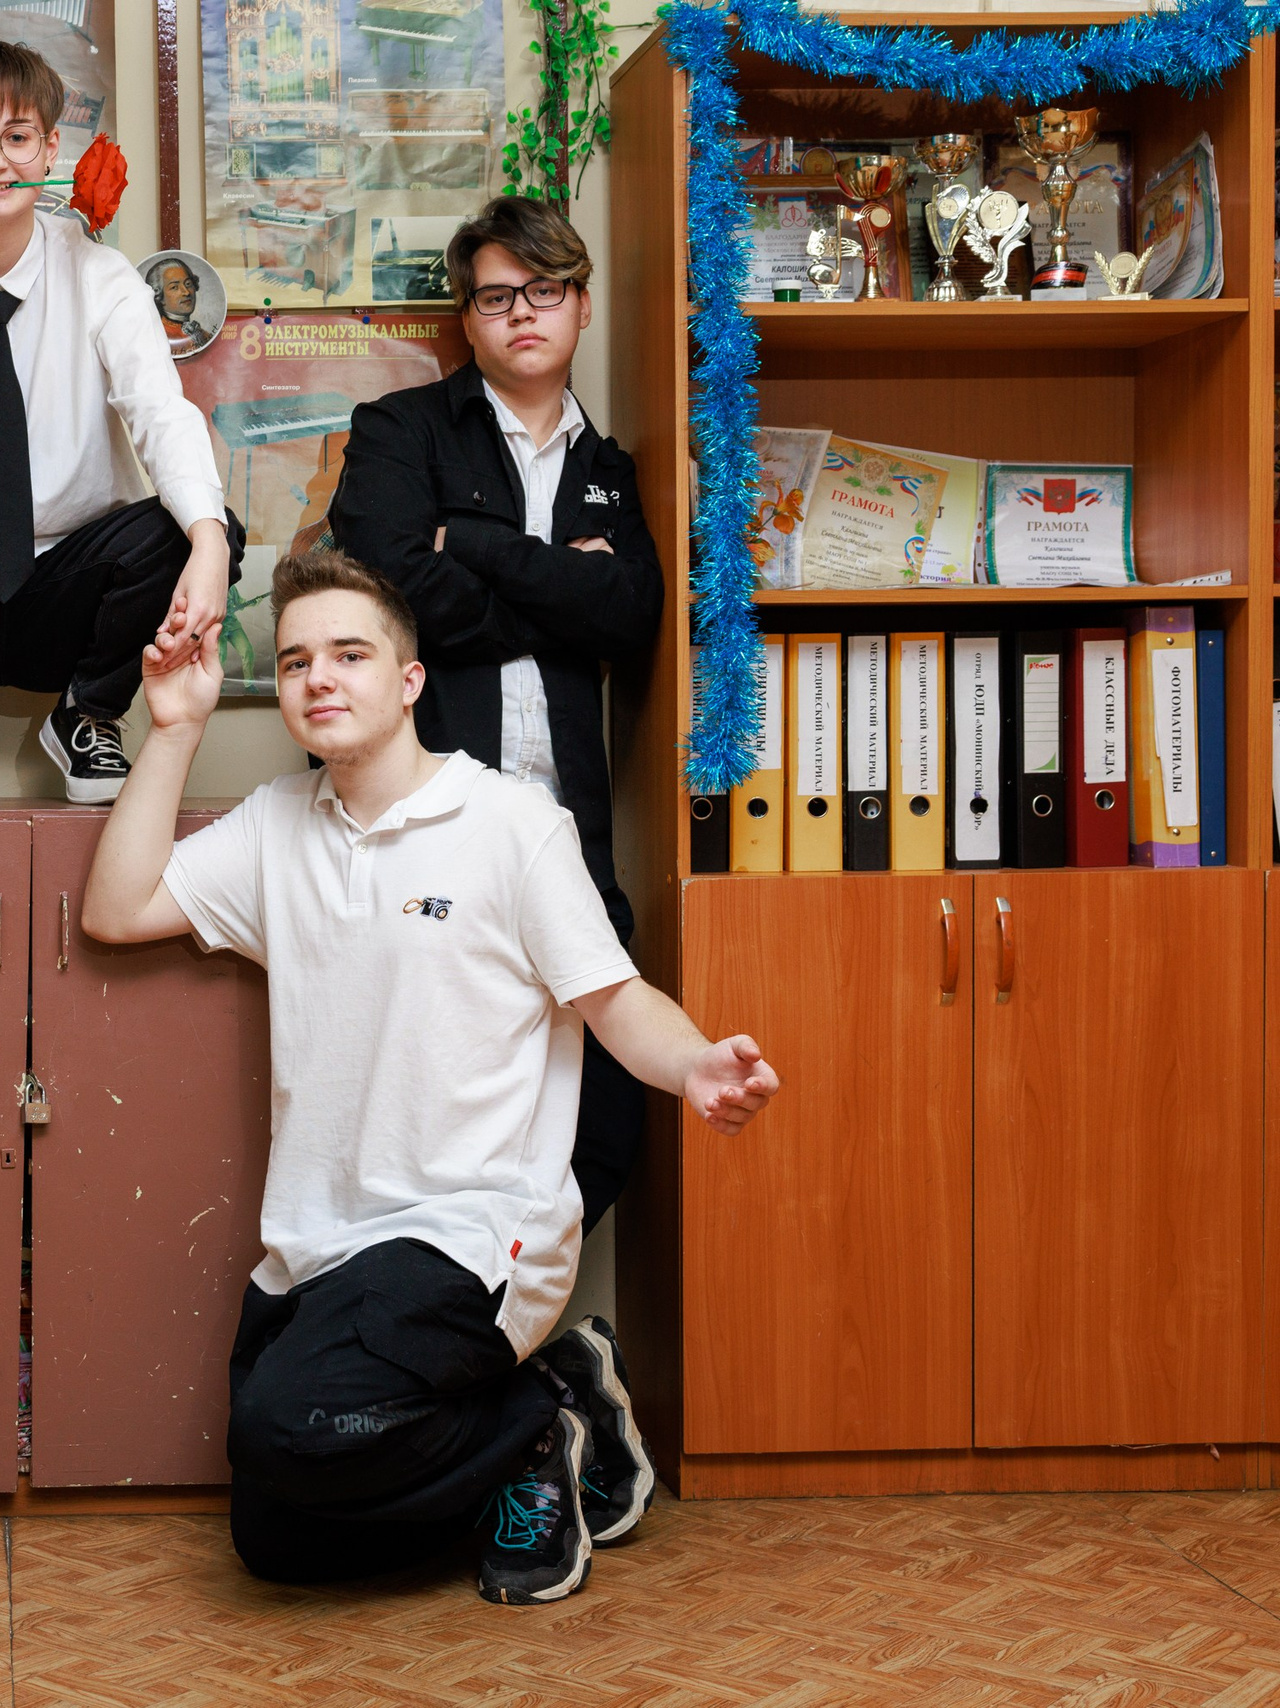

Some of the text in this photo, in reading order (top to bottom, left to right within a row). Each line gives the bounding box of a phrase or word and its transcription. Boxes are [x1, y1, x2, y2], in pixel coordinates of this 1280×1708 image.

[348, 76, 377, 84] Пианино
[239, 325, 261, 361] 8
[265, 324, 439, 340] ЭЛЕКТРОМУЗЫКАЛЬНЫЕ
[265, 341, 370, 356] ИНСТРУМЕНТЫ
[261, 384, 301, 392] Синтезатор
[831, 489, 895, 519] ГРАМОТА
[831, 510, 884, 531] НАГРАЖДАЕТСЯ
[1027, 521, 1090, 532] ГРАМОТА
[868, 641, 878, 788] МЕТОДИЧЕСКИЙ МАТЕРИАЛ
[974, 683, 985, 716] ЮДП
[814, 646, 824, 792] МЕТОДИЧЕСКИЙ МАТЕРИАЛ
[918, 645, 928, 791] МЕТОДИЧЕСКИЙ МАТЕРИАЛ
[1104, 657, 1115, 776] КЛАССНЫЕ ДЕЛА
[1171, 666, 1183, 793] ФОТОМАТЕРИАЛЫ
